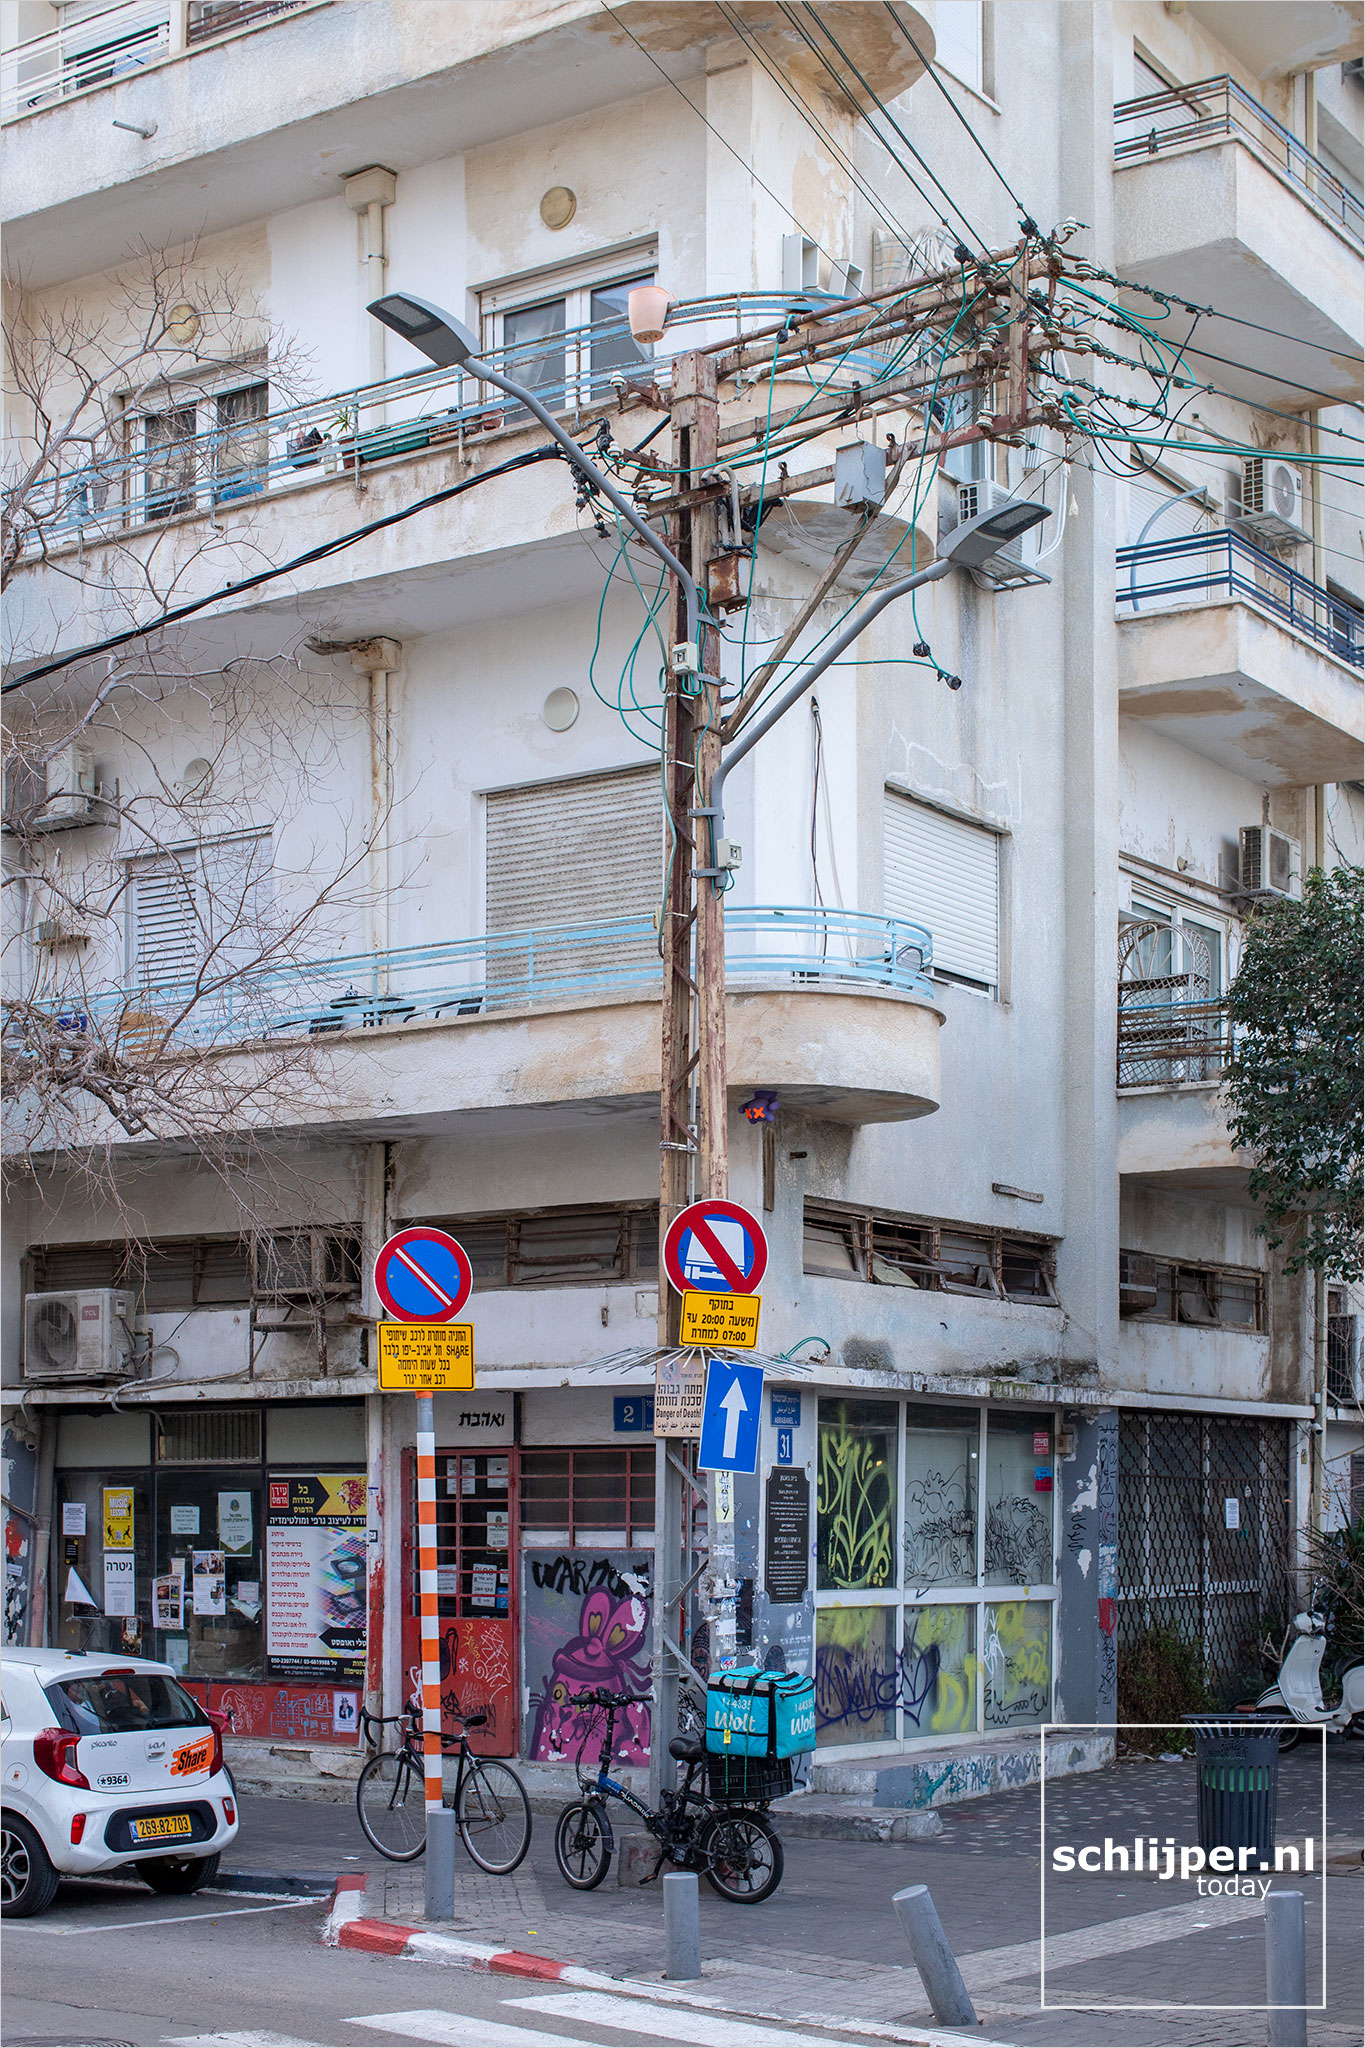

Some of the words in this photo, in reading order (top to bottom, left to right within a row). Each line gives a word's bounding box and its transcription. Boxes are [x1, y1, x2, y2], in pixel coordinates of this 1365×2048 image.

[709, 1299, 734, 1310] בתוקף
[686, 1312, 698, 1323] עד
[702, 1314, 725, 1325] 20:00
[728, 1315, 755, 1327] משעה
[386, 1330, 407, 1341] שיתופי
[410, 1328, 425, 1341] לרכב
[427, 1330, 446, 1341] מותרת
[448, 1330, 466, 1341] החניה
[691, 1328, 718, 1339] למחרת
[722, 1331, 746, 1341] 07:00
[383, 1343, 399, 1356] בלבד
[433, 1343, 442, 1355] תל
[446, 1345, 469, 1356] SHARE
[398, 1359, 418, 1370] היממה
[420, 1359, 436, 1370] שעות
[438, 1358, 450, 1370] בכל
[403, 1374, 417, 1385] יגרר
[419, 1374, 432, 1385] אחר
[434, 1374, 446, 1385] רכב
[657, 1384, 680, 1394] גבוה!
[684, 1384, 702, 1394] מתח
[656, 1396, 677, 1406] מוות!
[680, 1396, 702, 1406] סכנת
[458, 1412, 505, 1427] ואהבת
[623, 1405, 634, 1423] 2
[656, 1408, 675, 1420] Danger
[676, 1408, 682, 1418] of
[683, 1408, 701, 1418] Death!
[779, 1434, 790, 1458] 31
[271, 1486, 288, 1497] עידן
[297, 1483, 309, 1494] כל
[292, 1496, 315, 1504] עבודות
[293, 1506, 314, 1514] הדפוס
[269, 1515, 310, 1525] ומולטימדיה
[311, 1516, 326, 1525] גרפי
[328, 1516, 351, 1525] לעיצוב
[352, 1517, 366, 1525] ודיו
[106, 1561, 133, 1572] גיטרה
[714, 1710, 756, 1732] Wolt
[790, 1711, 816, 1736] Wolt
[91, 1740, 118, 1750] picanto
[178, 1749, 207, 1771] Share
